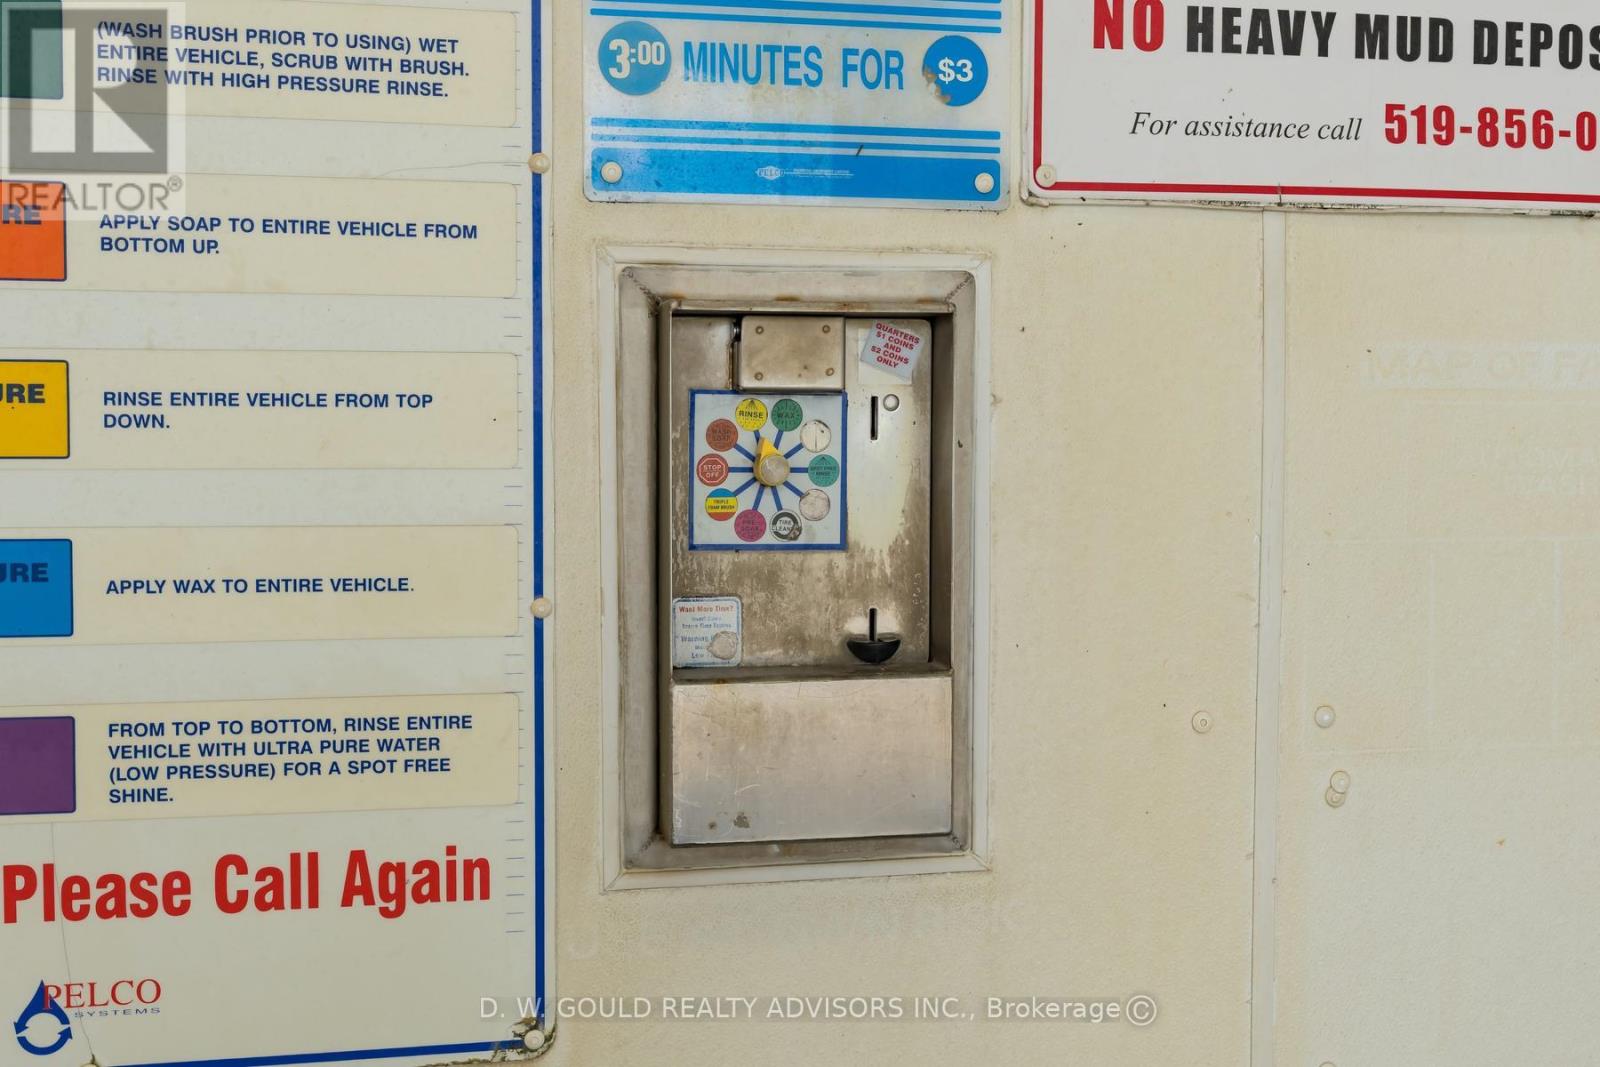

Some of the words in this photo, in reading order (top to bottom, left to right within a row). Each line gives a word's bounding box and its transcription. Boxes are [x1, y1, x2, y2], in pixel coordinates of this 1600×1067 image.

[97, 21, 163, 40] (WASH
[171, 26, 237, 42] BRUSH
[246, 29, 305, 45] PRIOR
[313, 32, 338, 47] TO
[346, 34, 410, 54] USING)
[419, 38, 458, 53] WET
[1093, 0, 1164, 52] NO
[1187, 6, 1336, 57] HEAVY
[1355, 13, 1453, 62] MUD
[97, 44, 168, 62] ENTIRE
[176, 48, 264, 69] VEHICLE,
[272, 53, 337, 69] SCRUB
[345, 56, 392, 72] WITH
[400, 59, 469, 76] BRUSH.
[609, 39, 665, 79] 3:00
[683, 40, 823, 88] MINUTES
[841, 47, 904, 90] FOR
[938, 57, 974, 84] $3
[97, 66, 157, 84] RINSE
[164, 69, 214, 87] WITH
[222, 73, 269, 88] HIGH
[278, 75, 379, 93] PRESSURE
[388, 81, 448, 97] RINSE.
[1130, 112, 1177, 135] For
[1185, 116, 1310, 138] assistance
[1318, 118, 1362, 140] call
[1385, 104, 1596, 151] 519-856-0
[100, 215, 160, 230] APPLY
[168, 217, 221, 231] SOAP
[228, 218, 254, 233] TO
[263, 219, 330, 234] ENTIRE
[337, 221, 416, 237] VEHICLE
[425, 224, 477, 238] FROM
[101, 237, 184, 253] BOTTOM
[193, 239, 219, 254] UP.
[876, 322, 920, 344] QUARTERS
[888, 336, 914, 350] COINS
[883, 351, 909, 364] COINS
[884, 343, 901, 353] AND
[877, 356, 899, 368] ONLY
[0, 383, 46, 404] RE
[104, 392, 162, 406] RINSE
[171, 392, 239, 406] ENTIRE
[247, 393, 327, 407] VEHICLE
[335, 394, 388, 408] FROM
[396, 394, 432, 408] TOP
[103, 414, 171, 429] DOWN.
[739, 411, 763, 419] RINSE
[777, 411, 795, 419] WAX
[107, 580, 166, 594] APPLY
[173, 580, 215, 593] WAX
[222, 579, 248, 593] TO
[256, 579, 323, 592] ENTIRE
[330, 577, 414, 593] VEHICLE.
[109, 723, 164, 737] FROM
[172, 722, 210, 736] TOP
[218, 721, 243, 734] TO
[251, 719, 336, 734] BOTTOM,
[345, 717, 399, 731] RINSE
[408, 715, 472, 730] ENTIRE
[108, 744, 190, 759] VEHICLE
[198, 742, 245, 757] WITH
[254, 741, 313, 755] ULTRA
[320, 739, 369, 753] PURE
[377, 738, 439, 752] WATER
[110, 766, 159, 784] (LOW
[167, 763, 275, 780] PRESSURE)
[284, 762, 321, 776] FOR
[329, 761, 341, 775] A
[348, 760, 397, 774] SPOT
[405, 758, 450, 772] FREE
[109, 788, 173, 803] SHINE.
[2, 863, 192, 924] Please
[214, 851, 320, 914] Call
[340, 845, 491, 919] Again
[42, 978, 162, 1010] PELCO
[74, 1007, 162, 1019] SYSTEMS
